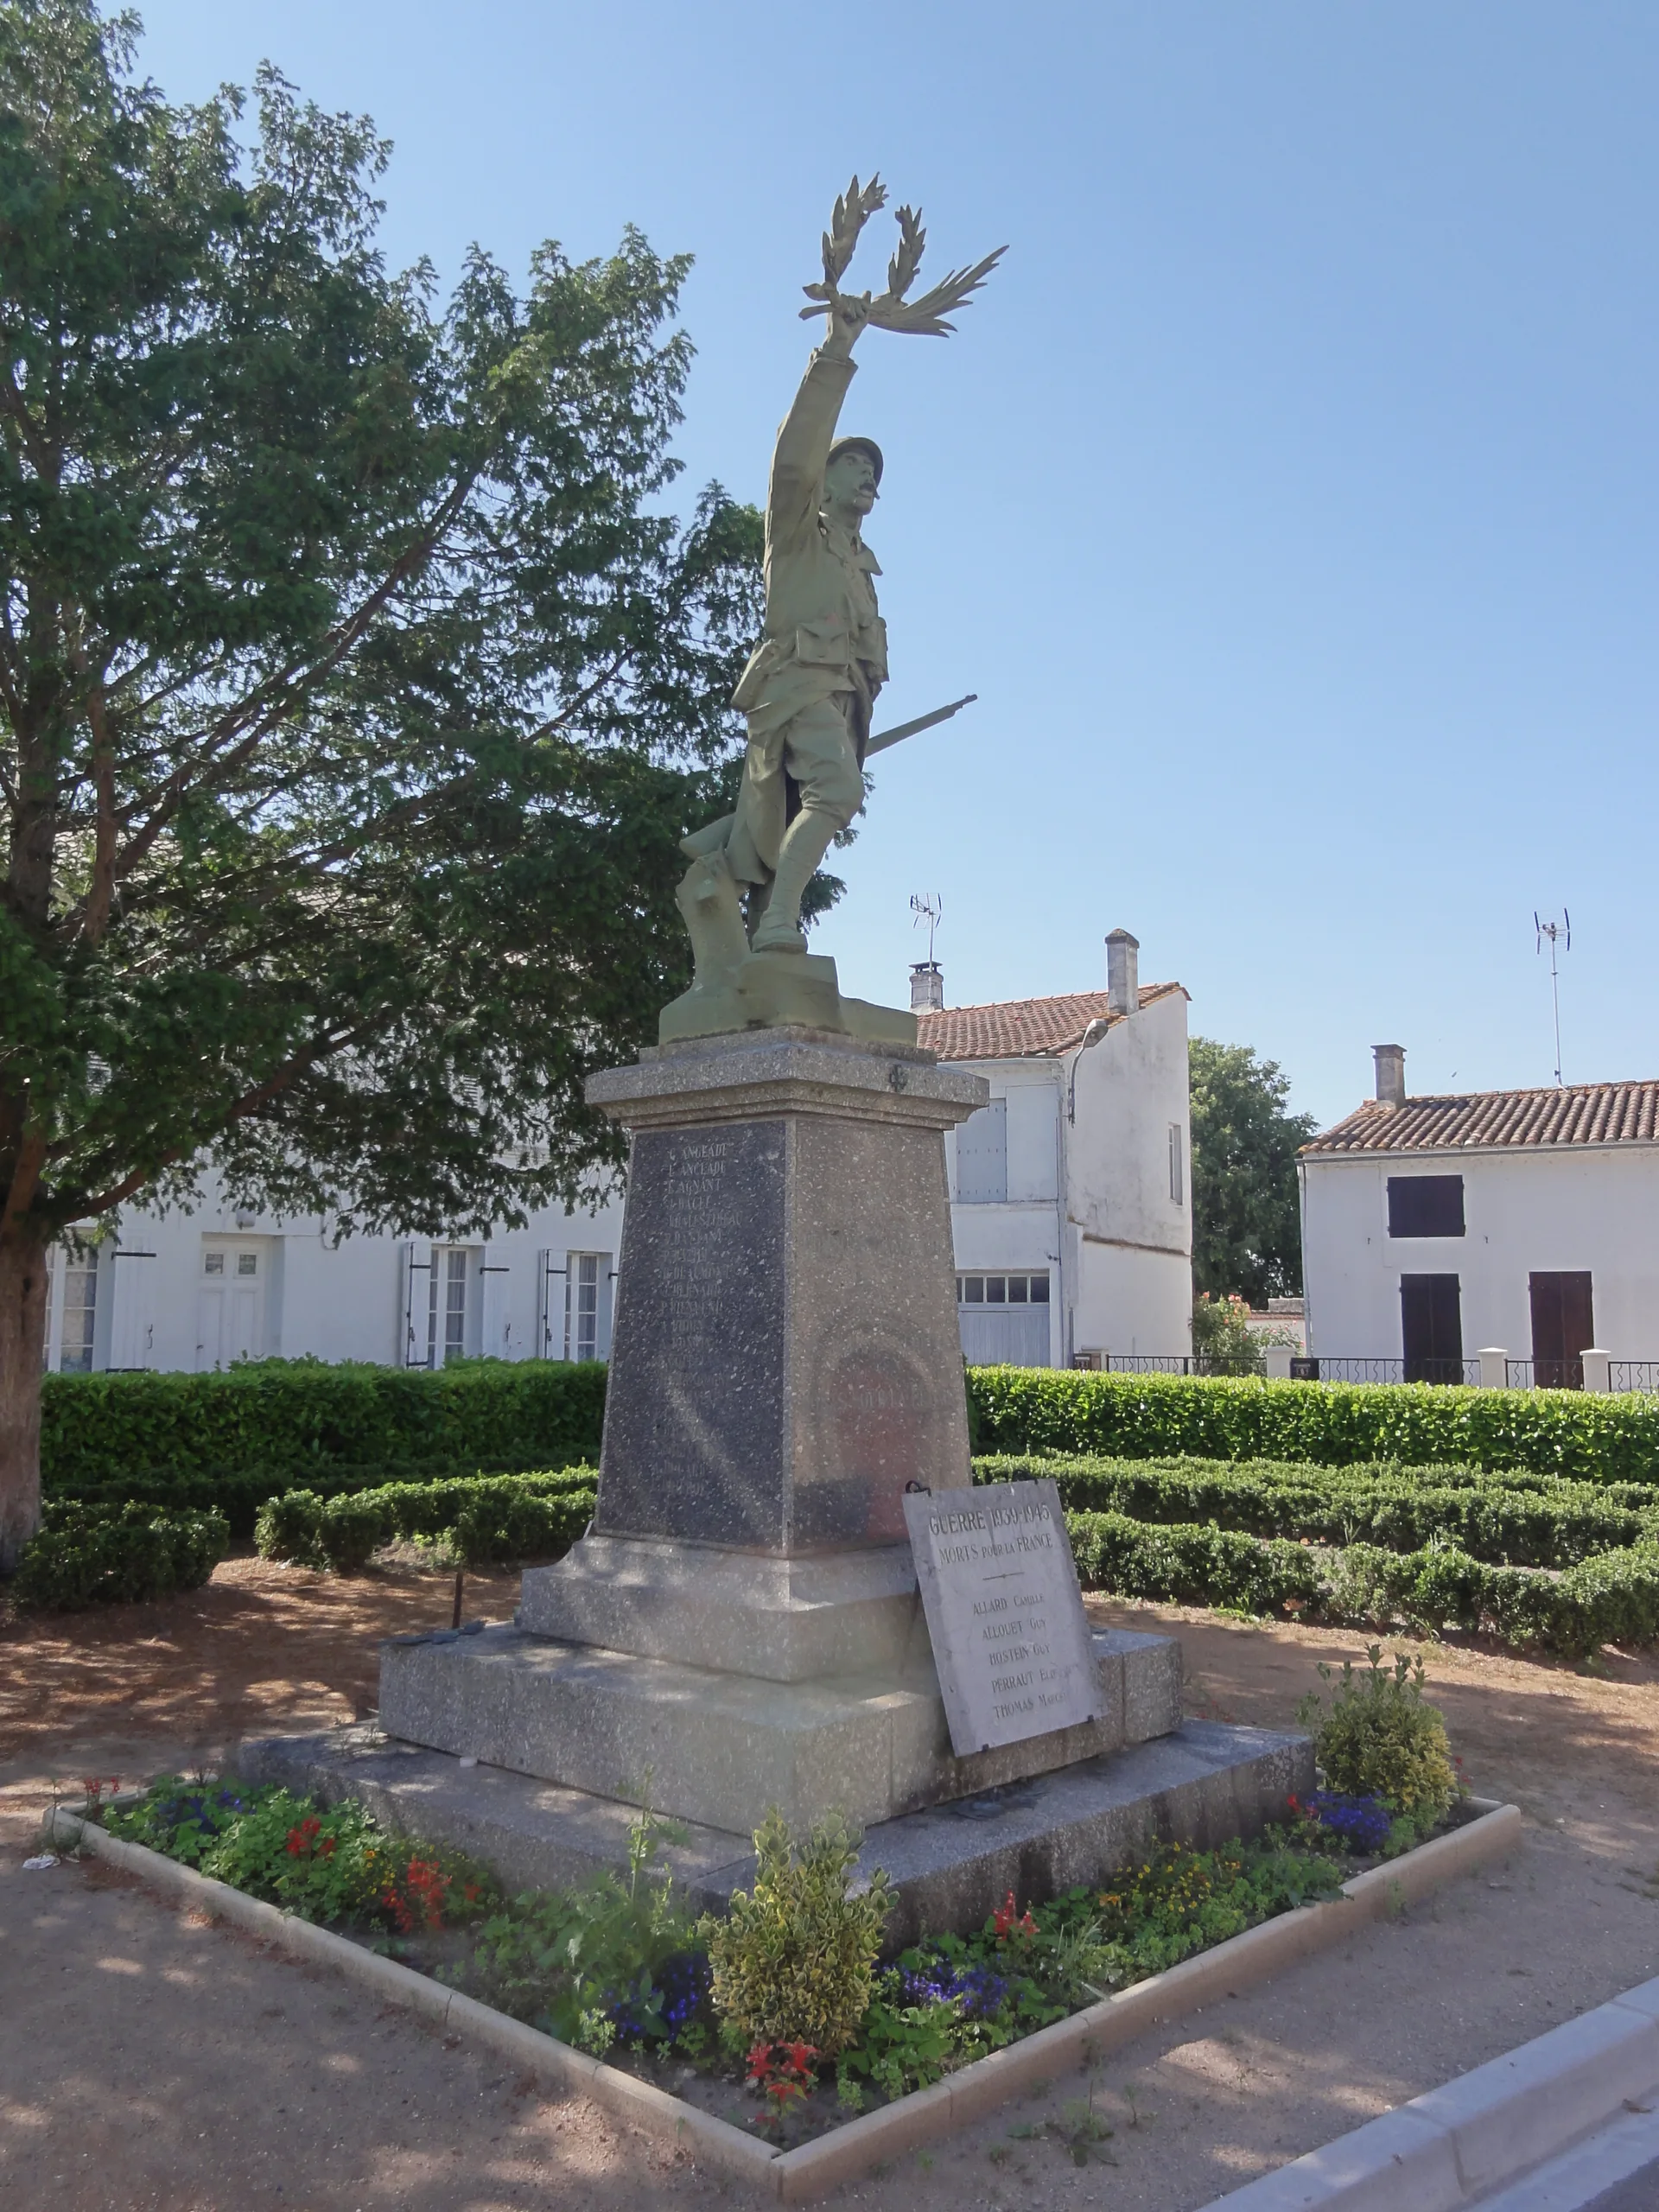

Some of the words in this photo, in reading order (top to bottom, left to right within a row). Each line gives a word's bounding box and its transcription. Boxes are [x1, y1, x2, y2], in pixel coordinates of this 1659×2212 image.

[929, 1510, 986, 1535] GUERRE
[990, 1503, 1051, 1528] 1939-1945
[938, 1544, 978, 1565] MORTS
[982, 1543, 1004, 1558] POUR
[1004, 1542, 1015, 1554] LA
[1017, 1533, 1053, 1552] FRANCE
[973, 1597, 1007, 1615] ALLARD
[982, 1620, 1023, 1640] ALLOUET
[989, 1645, 1030, 1665] HOSTEIN
[991, 1670, 1033, 1694] PERRAUT
[993, 1697, 1034, 1719] THOMAS
